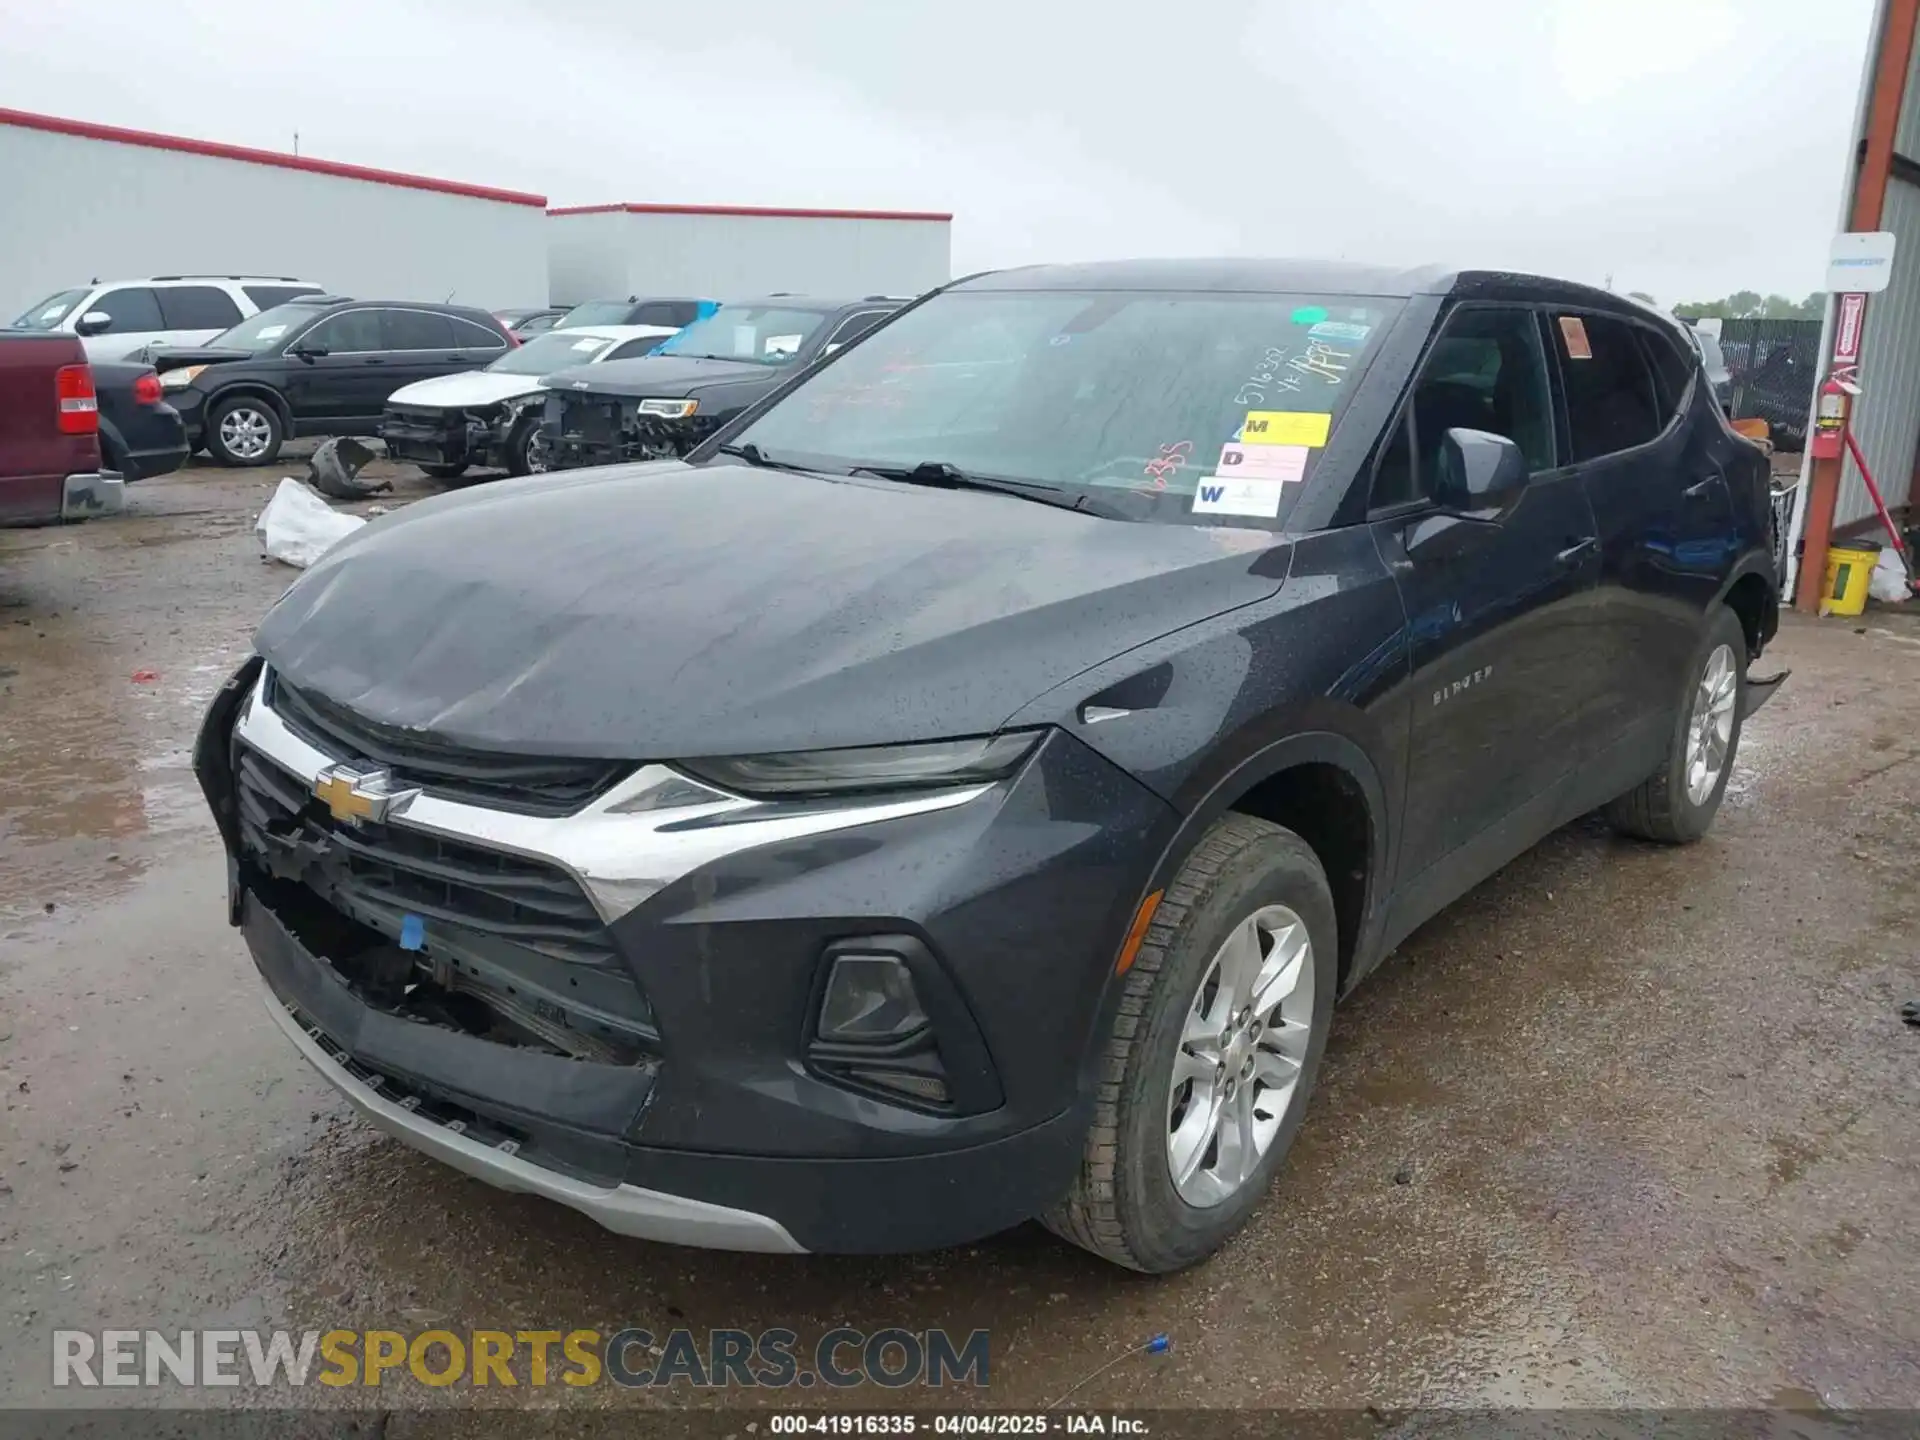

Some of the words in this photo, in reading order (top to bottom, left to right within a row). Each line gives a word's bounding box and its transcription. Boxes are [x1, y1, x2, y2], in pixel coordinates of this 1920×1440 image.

[1246, 420, 1268, 432] M
[1223, 452, 1244, 465] D
[1200, 486, 1225, 502] W
